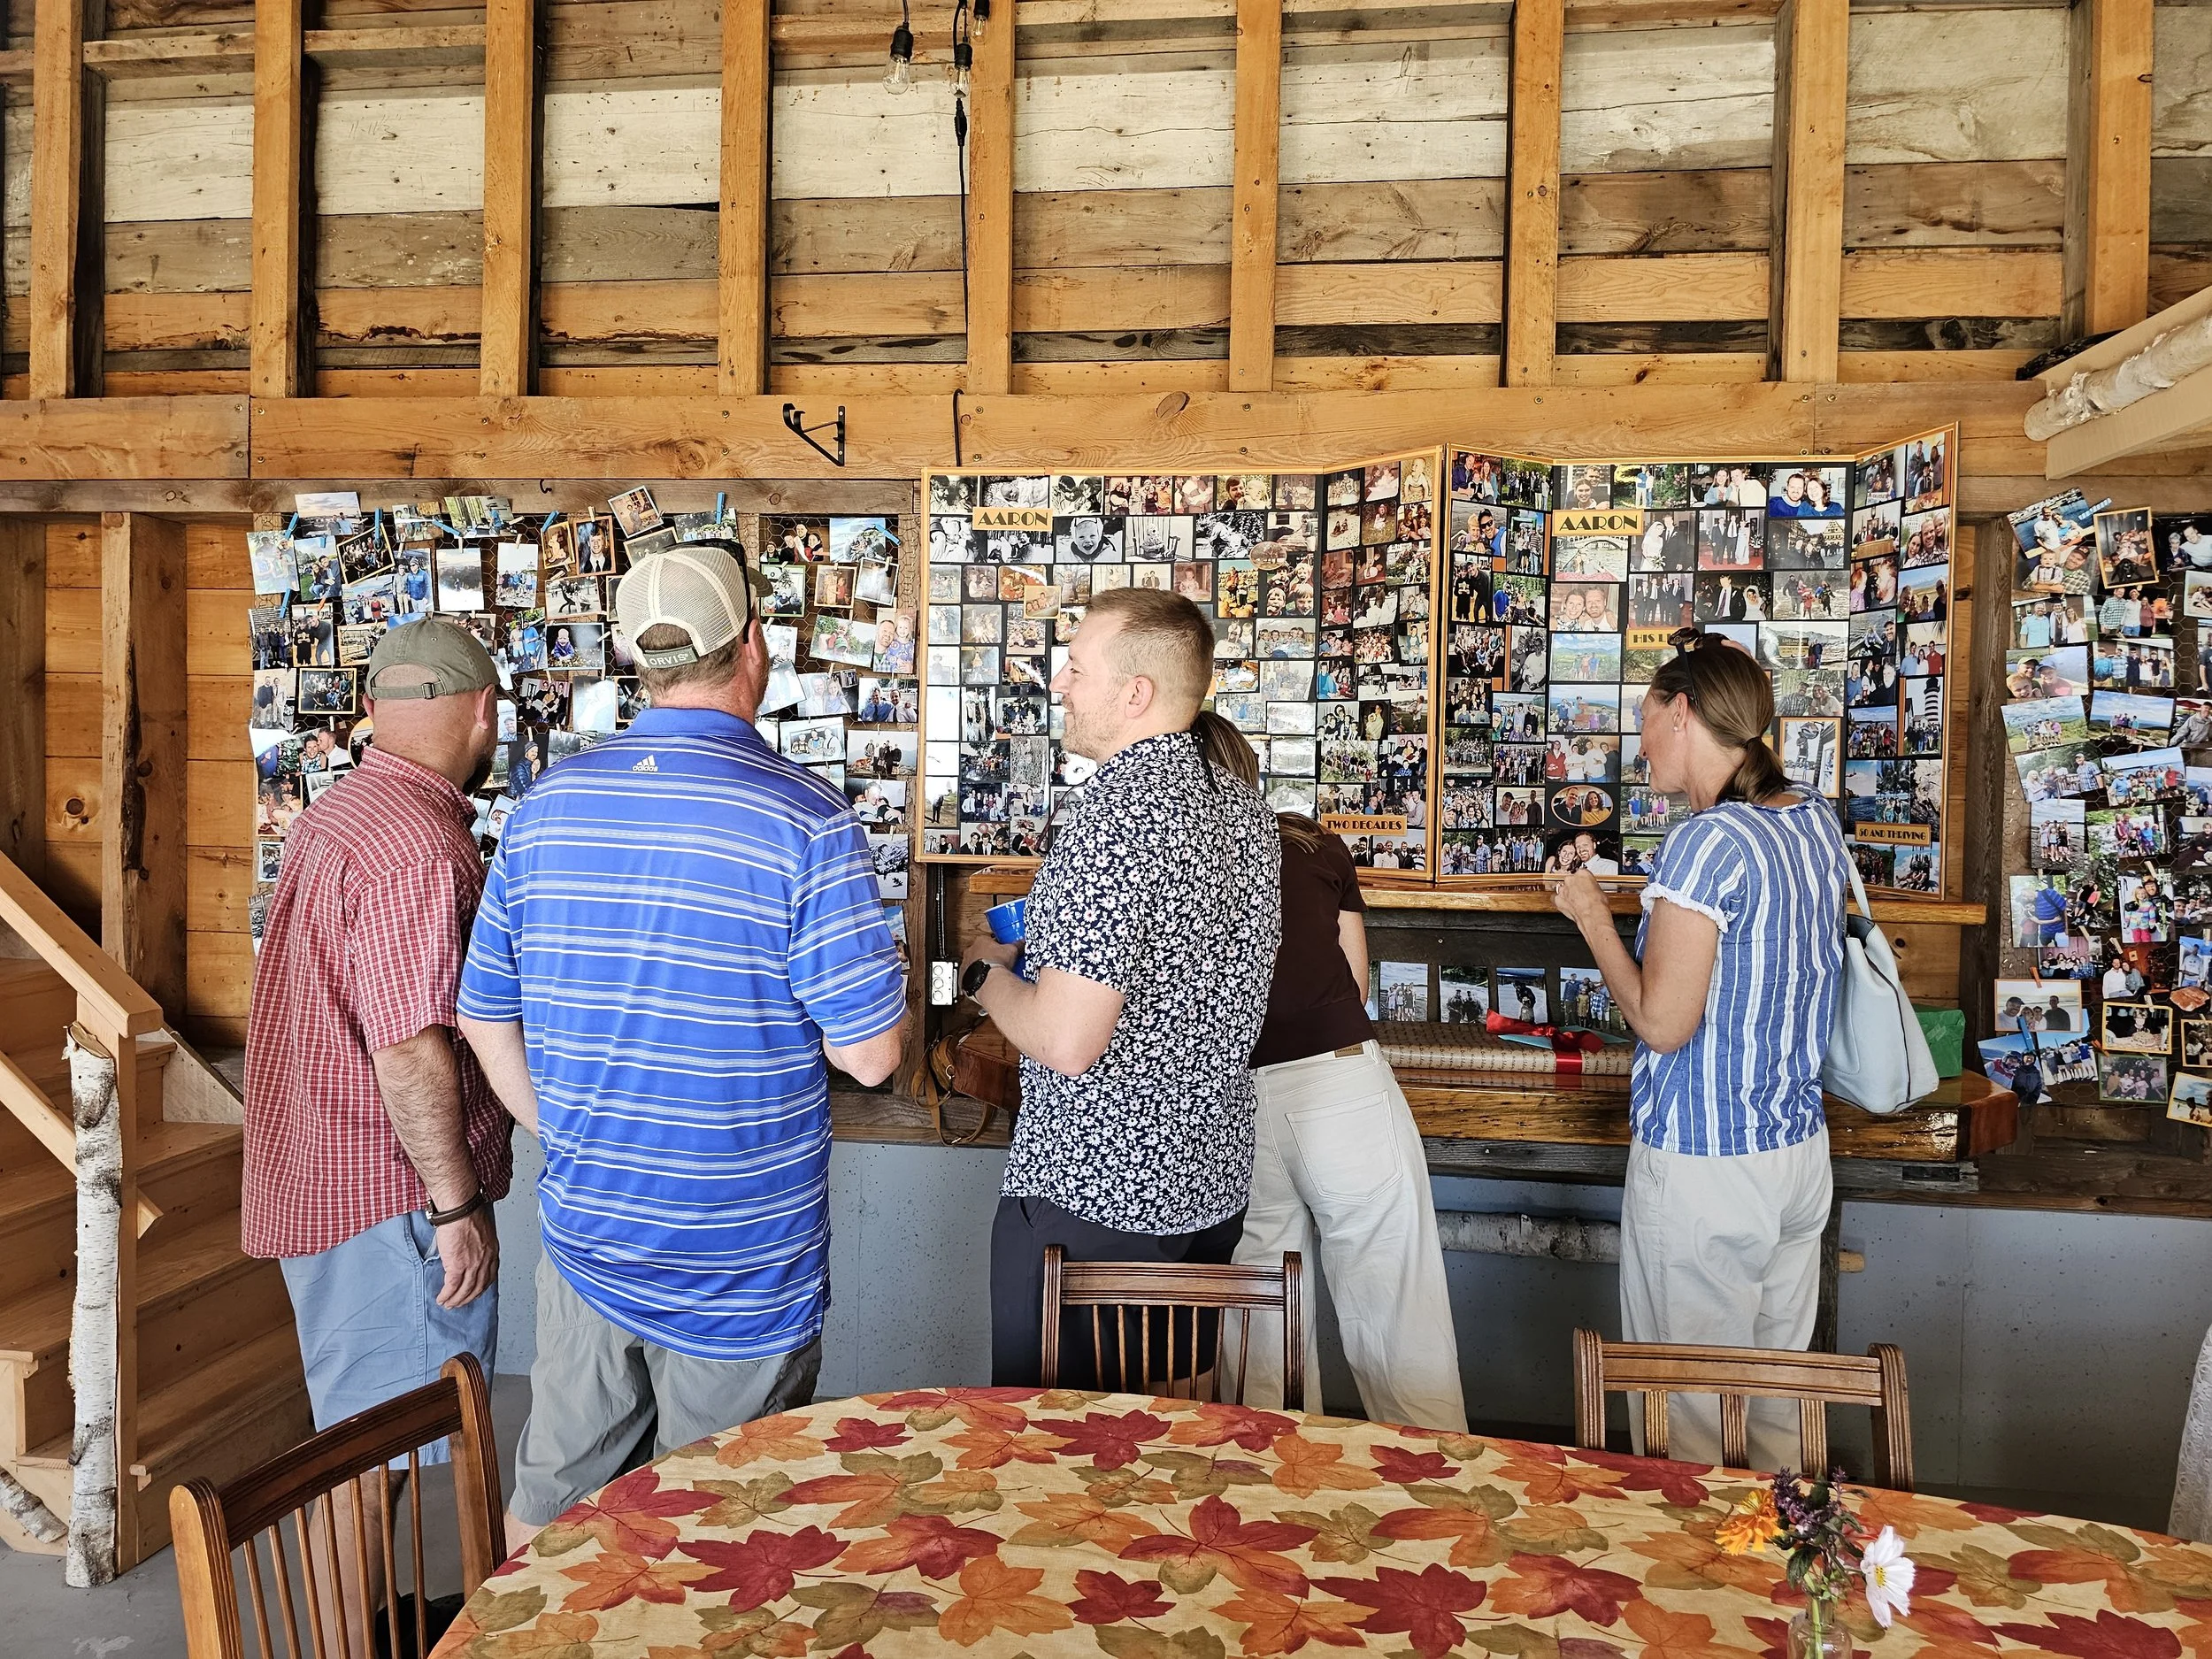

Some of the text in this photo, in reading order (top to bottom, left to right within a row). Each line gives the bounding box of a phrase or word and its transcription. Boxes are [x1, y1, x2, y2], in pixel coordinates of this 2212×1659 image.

[978, 511, 1048, 526] AARON
[1559, 514, 1638, 531] AARON
[1633, 634, 1655, 643] HIS
[1326, 820, 1402, 830] TWO DECADES
[1870, 828, 1886, 838] AND
[1887, 830, 1926, 841] THRIVING
